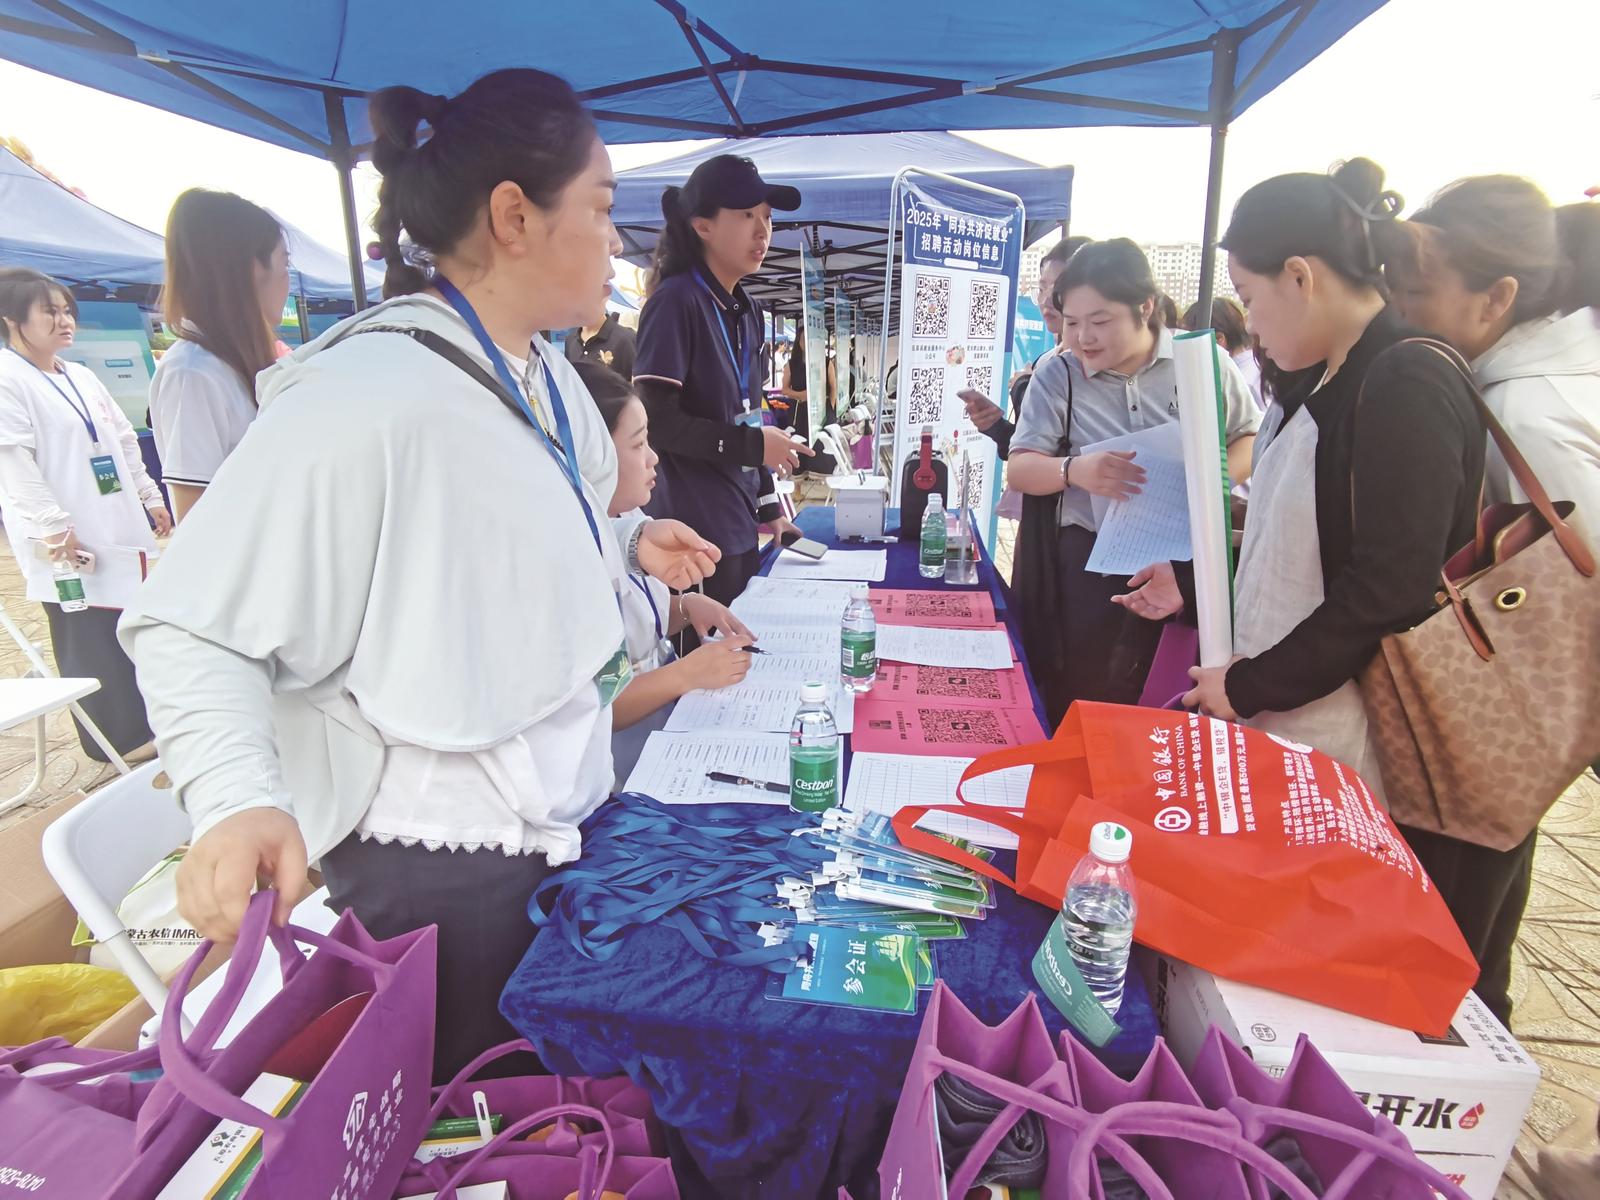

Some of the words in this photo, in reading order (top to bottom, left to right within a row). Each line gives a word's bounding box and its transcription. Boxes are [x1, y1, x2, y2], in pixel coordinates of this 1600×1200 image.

[921, 232, 999, 262] 招聘活动岗位信息
[1175, 725, 1185, 756] CHINA
[1149, 726, 1176, 801] 中国银行
[1178, 757, 1186, 770] OF
[1178, 771, 1188, 798] BANK
[122, 928, 171, 939] 蒙古农信
[842, 939, 868, 996] 参会证
